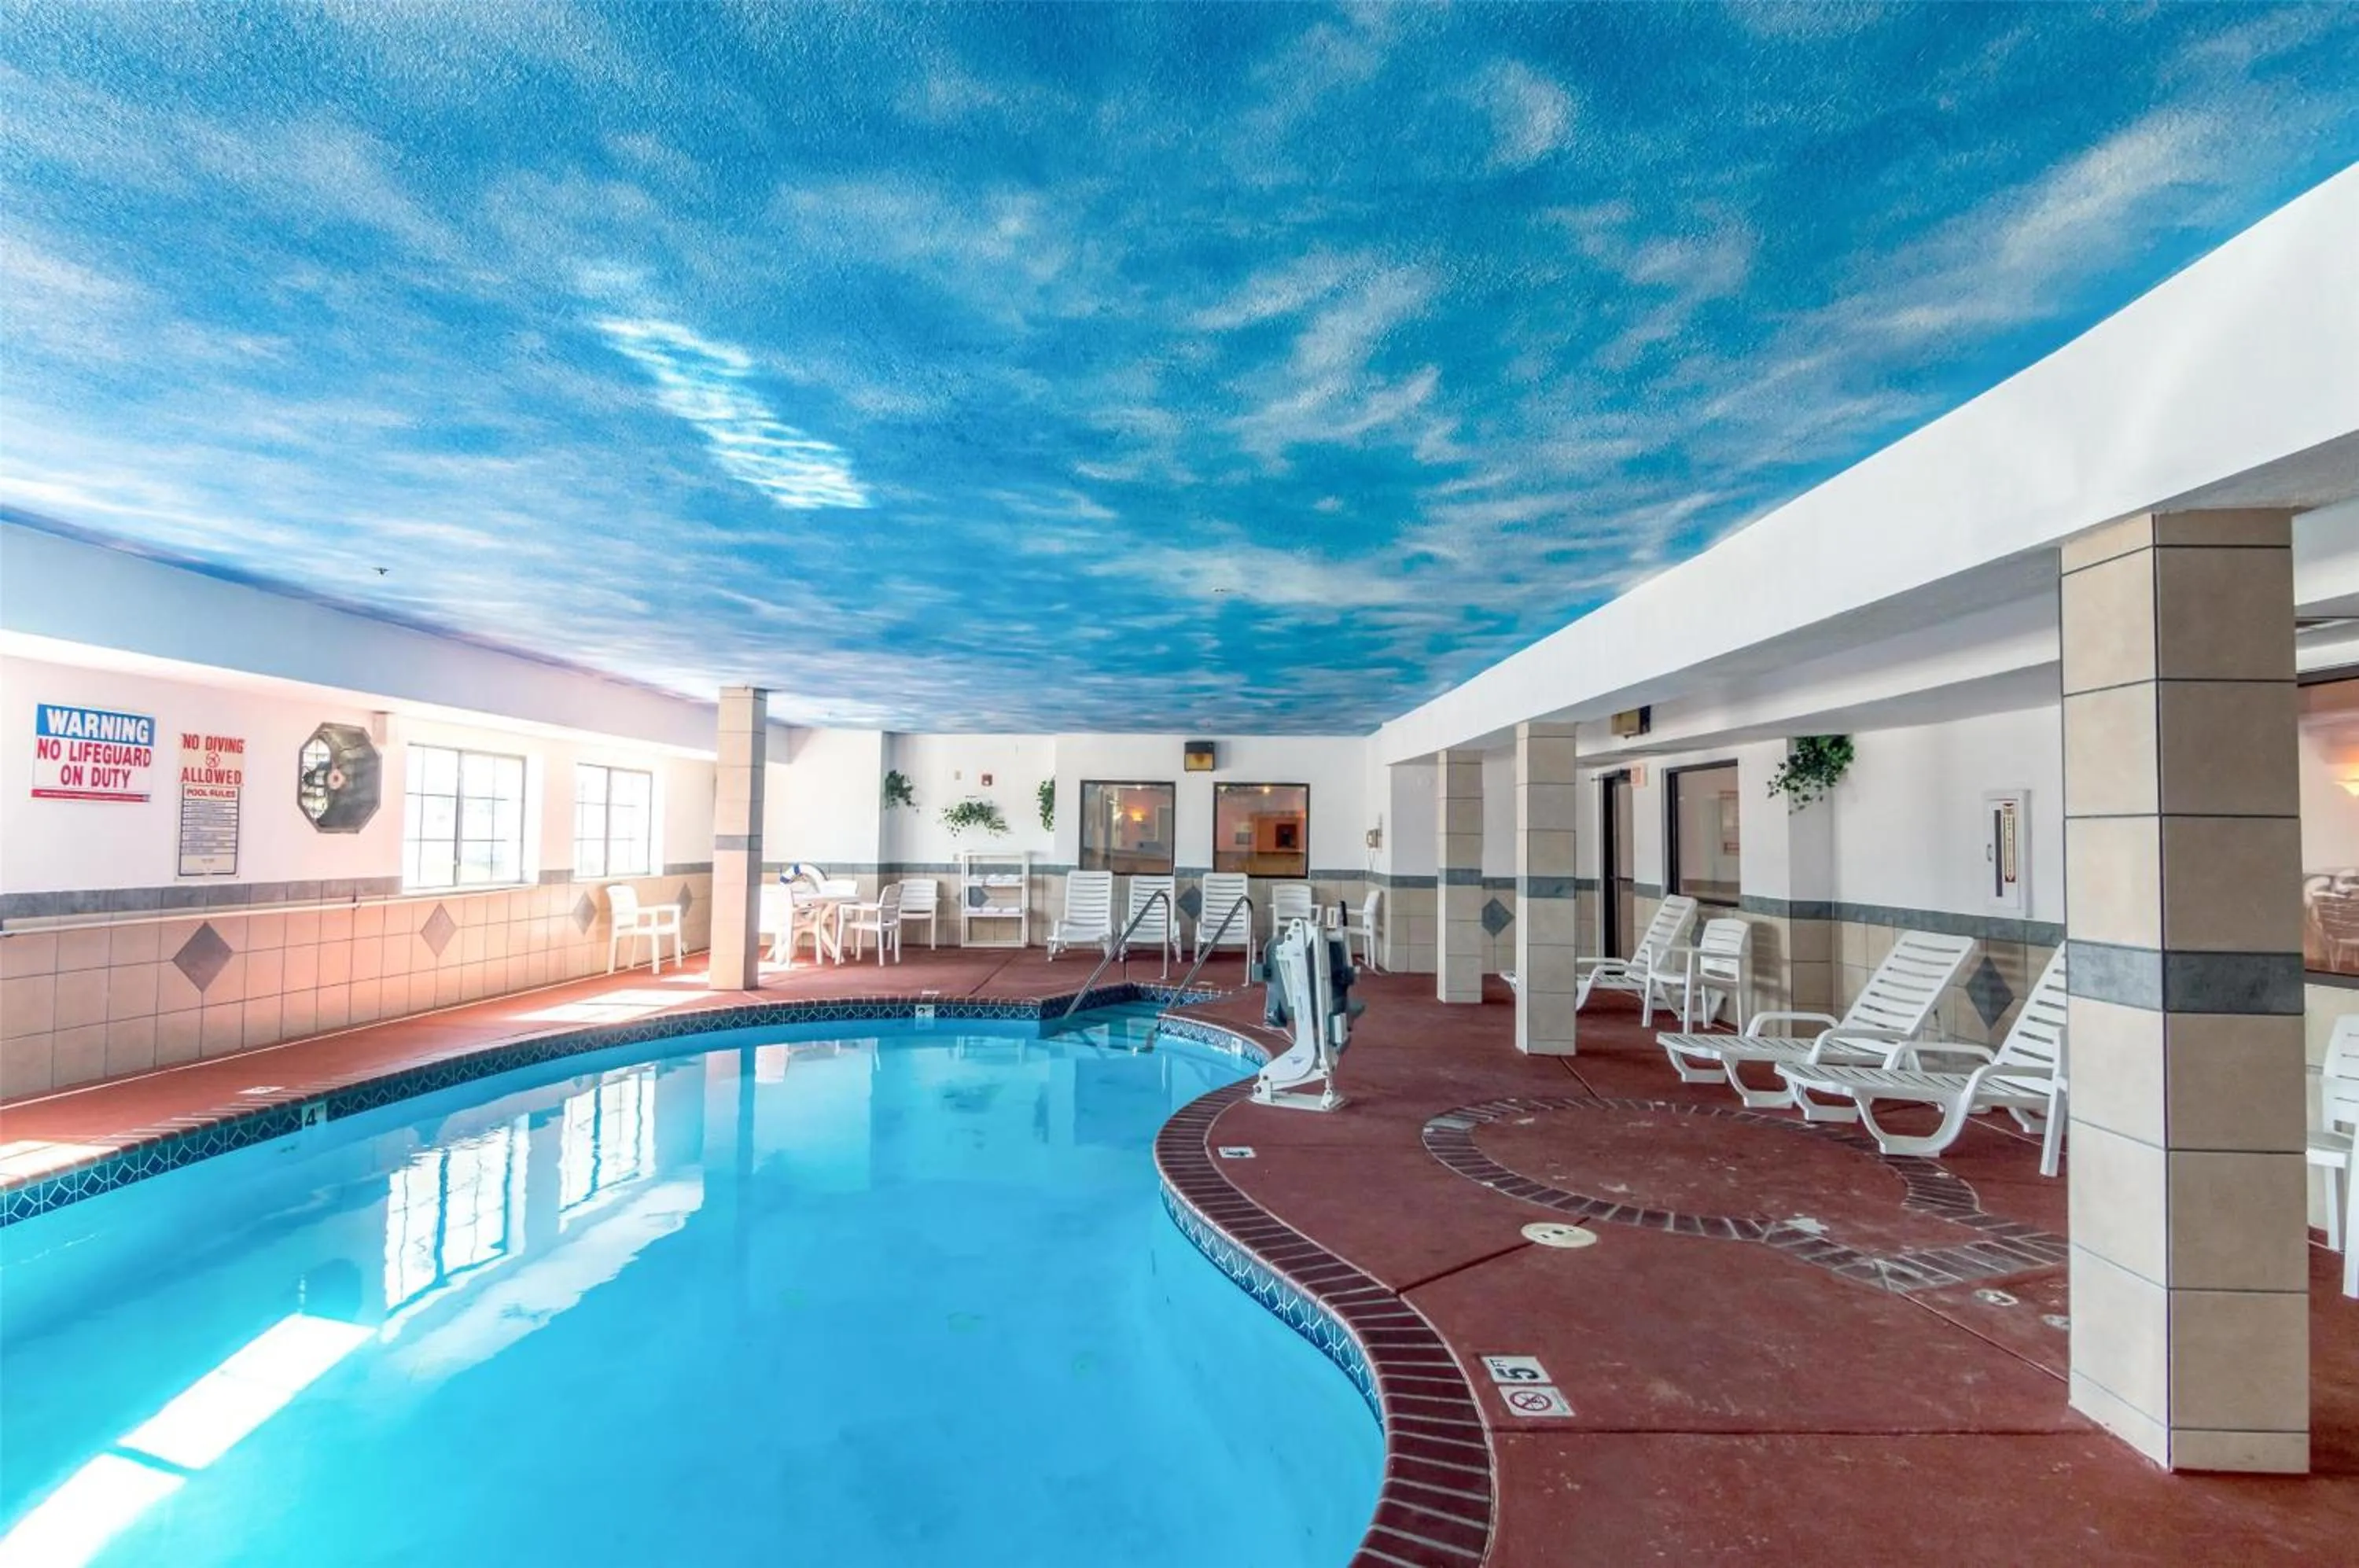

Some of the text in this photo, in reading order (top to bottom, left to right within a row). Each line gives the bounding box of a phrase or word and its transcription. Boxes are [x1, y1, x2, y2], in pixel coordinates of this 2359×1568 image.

[46, 709, 149, 744] WARNING
[37, 738, 153, 768] NO LIFEGUARD
[182, 733, 245, 754] NO DIVING
[61, 764, 131, 789] ON DUTY
[181, 767, 241, 786] ALLOWED
[209, 789, 236, 798] RULES
[305, 1107, 318, 1127] 4
[1495, 1367, 1539, 1380] 5
